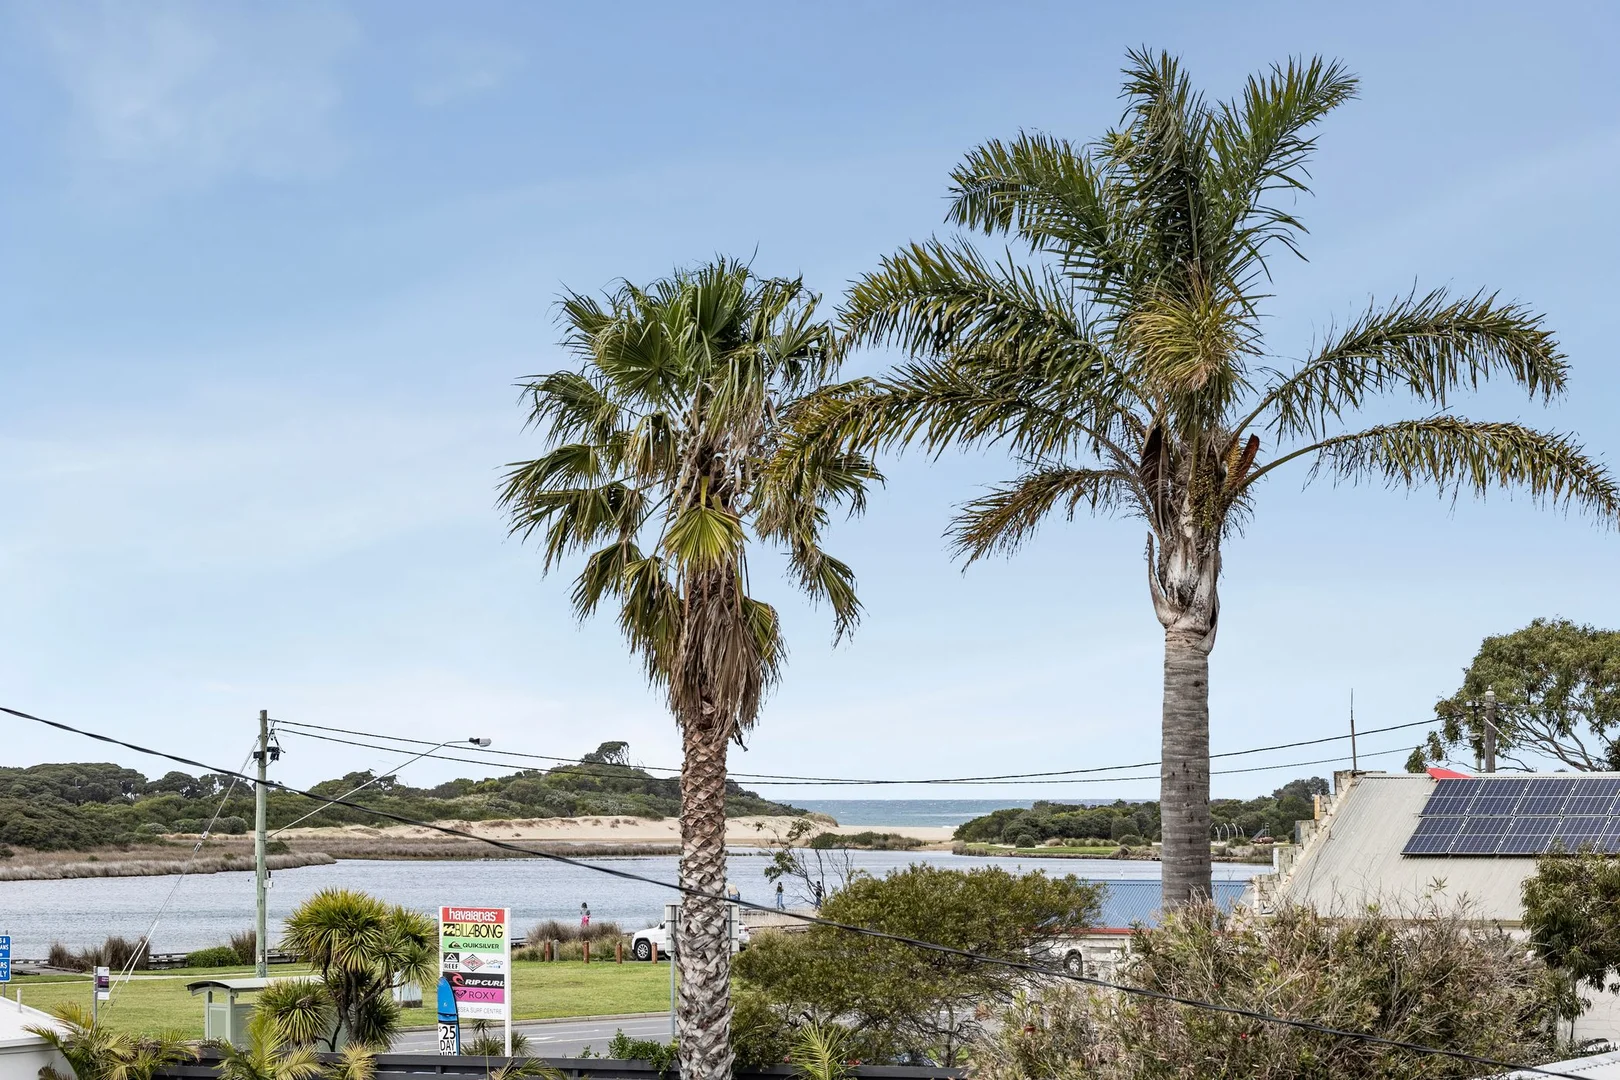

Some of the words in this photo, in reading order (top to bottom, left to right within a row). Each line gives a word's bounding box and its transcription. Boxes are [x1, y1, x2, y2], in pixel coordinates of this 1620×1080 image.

[449, 908, 496, 922] havaianas
[455, 923, 503, 938] BILLABONG
[468, 991, 496, 1000] ROXY
[440, 1040, 455, 1051] DAY
